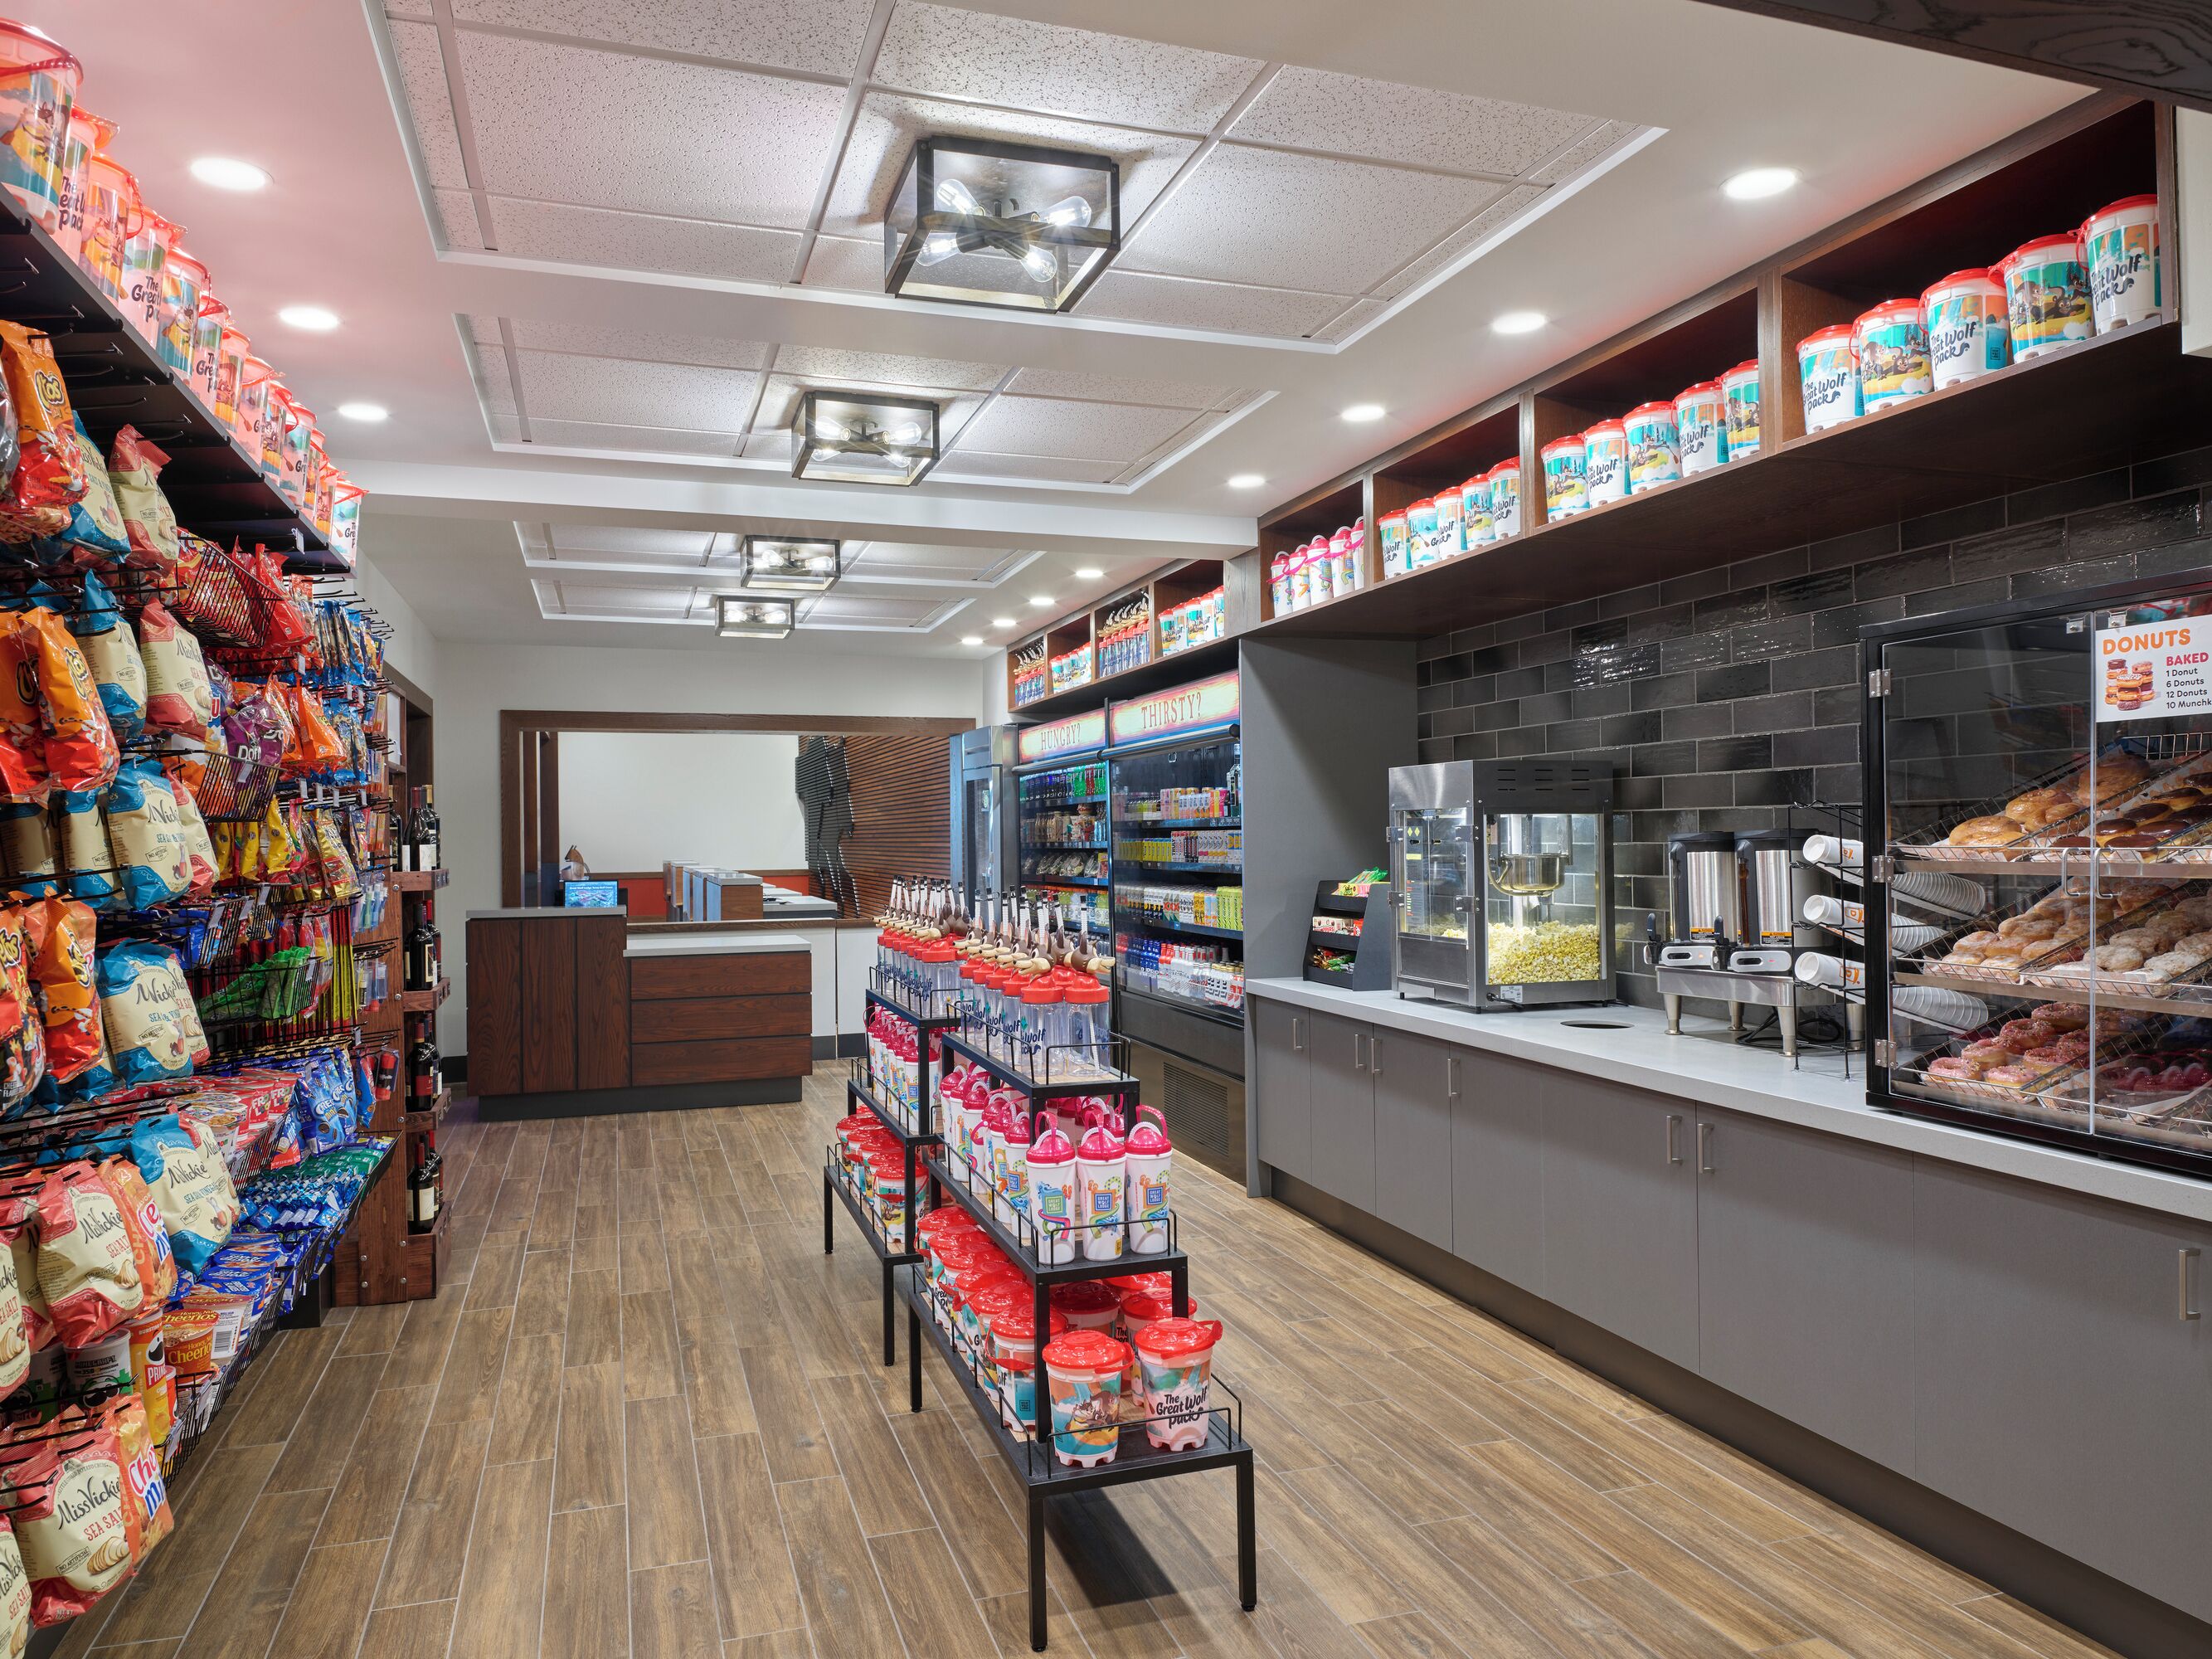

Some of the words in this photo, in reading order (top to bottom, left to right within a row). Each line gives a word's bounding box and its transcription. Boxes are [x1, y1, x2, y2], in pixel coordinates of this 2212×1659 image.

[2106, 253, 2142, 285] Wolf
[146, 275, 159, 291] The
[1944, 321, 1976, 348] Wolf
[1818, 372, 1847, 393] Wolf
[1685, 425, 1709, 446] Wolf
[1596, 458, 1617, 476] Wolf
[1499, 495, 1516, 513] Wolf
[2103, 628, 2191, 655] DONUTS
[2166, 652, 2210, 667] BAKED
[2171, 668, 2198, 678] Donut
[2174, 678, 2205, 688] Donuts
[2176, 689, 2208, 698] Donuts
[1140, 692, 1203, 730] THIRSTY?
[2166, 701, 2176, 709] 10
[1040, 722, 1082, 751] HUNGRY?
[1156, 1400, 1184, 1415] Great
[1184, 1385, 1208, 1410] Wolf
[1164, 1394, 1179, 1404] The
[84, 1521, 105, 1541] SEA
[59, 1563, 67, 1571] NO
[67, 1548, 90, 1567] ARTIFICIAL
